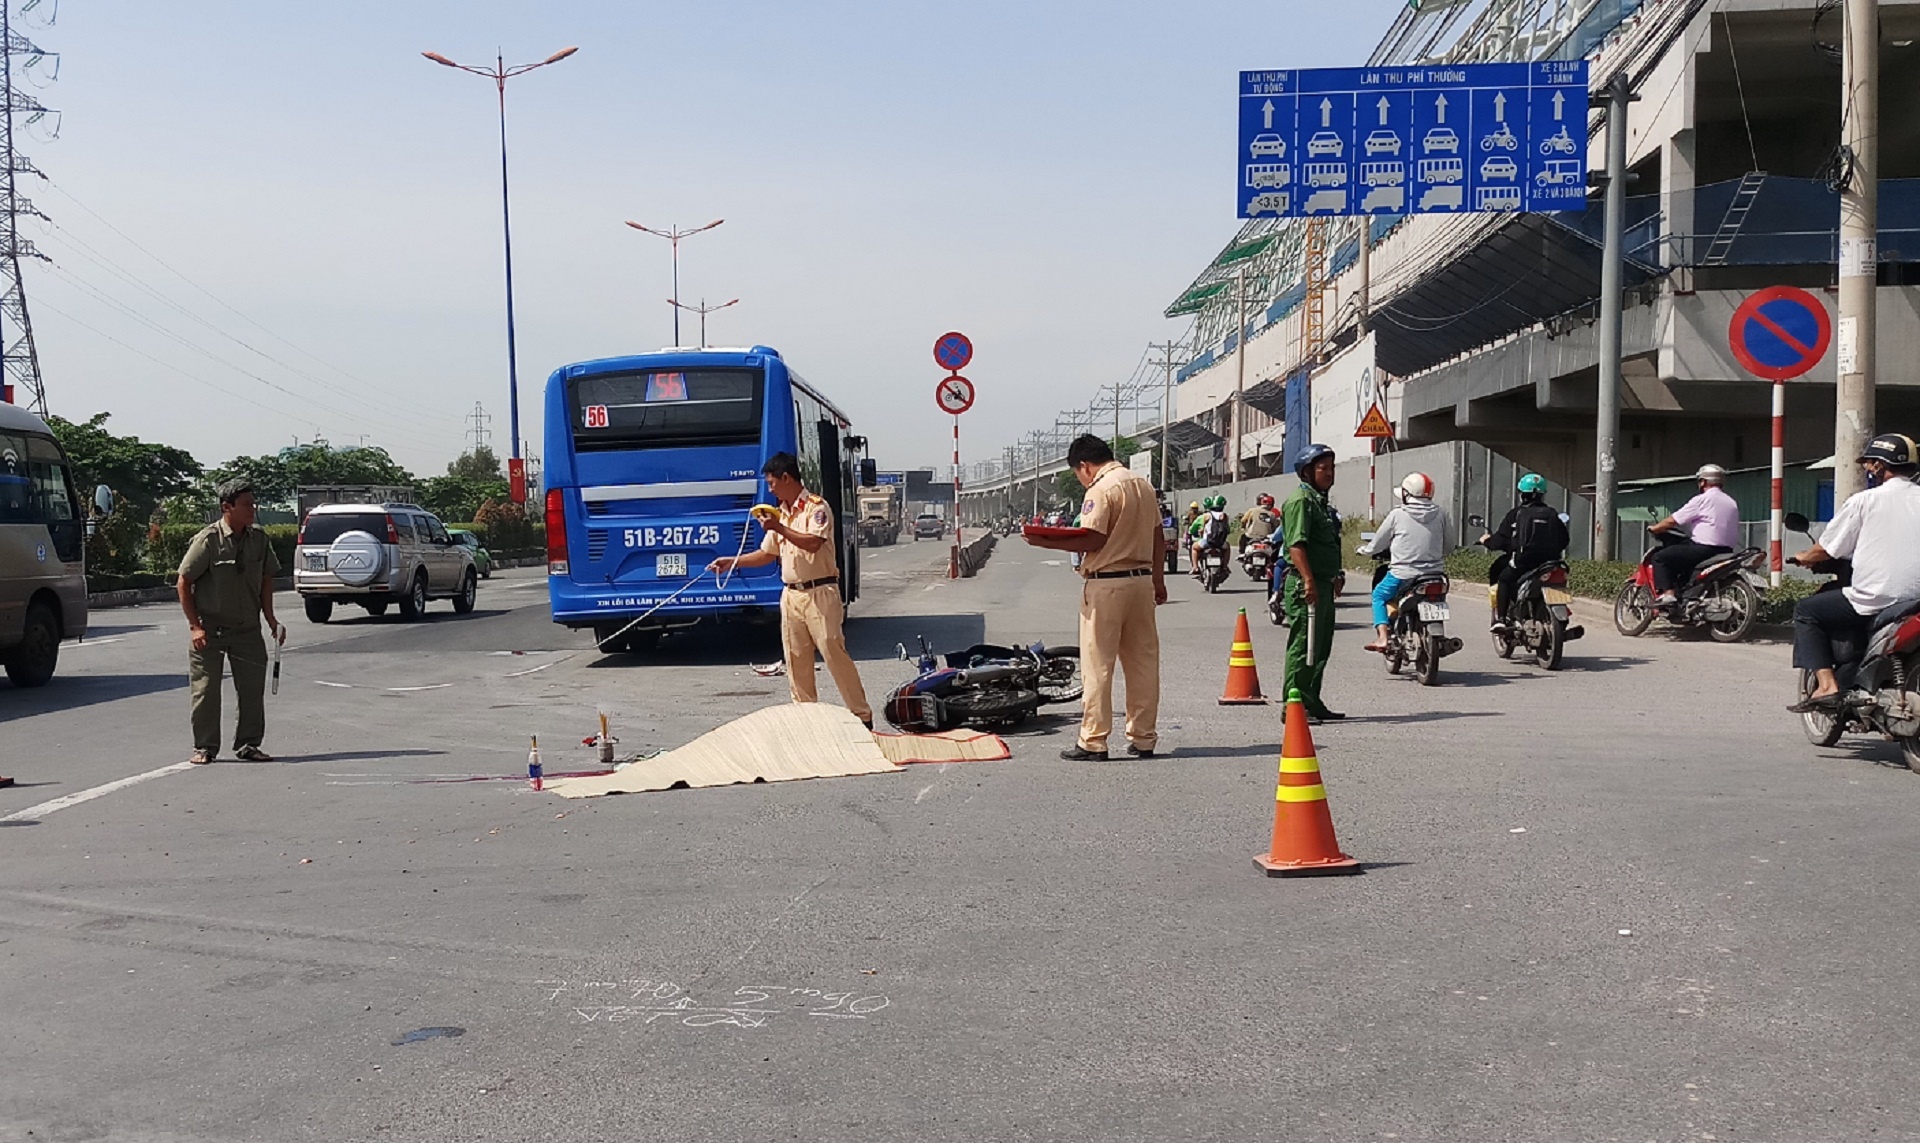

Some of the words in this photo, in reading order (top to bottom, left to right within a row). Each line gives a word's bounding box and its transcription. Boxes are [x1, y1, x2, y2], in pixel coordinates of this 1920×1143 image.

[1541, 62, 1551, 73] XE
[1553, 62, 1558, 72] 2
[1263, 71, 1276, 82] THU
[1360, 71, 1380, 84] LÀN
[1384, 73, 1403, 84] THU
[1407, 69, 1424, 83] PHÍ
[1428, 68, 1466, 83] THƯỜNG
[1547, 74, 1552, 84] 3
[655, 372, 681, 399] 56
[588, 406, 605, 427] 56
[624, 525, 720, 548] 51B-267.25
[663, 555, 681, 565] 51B
